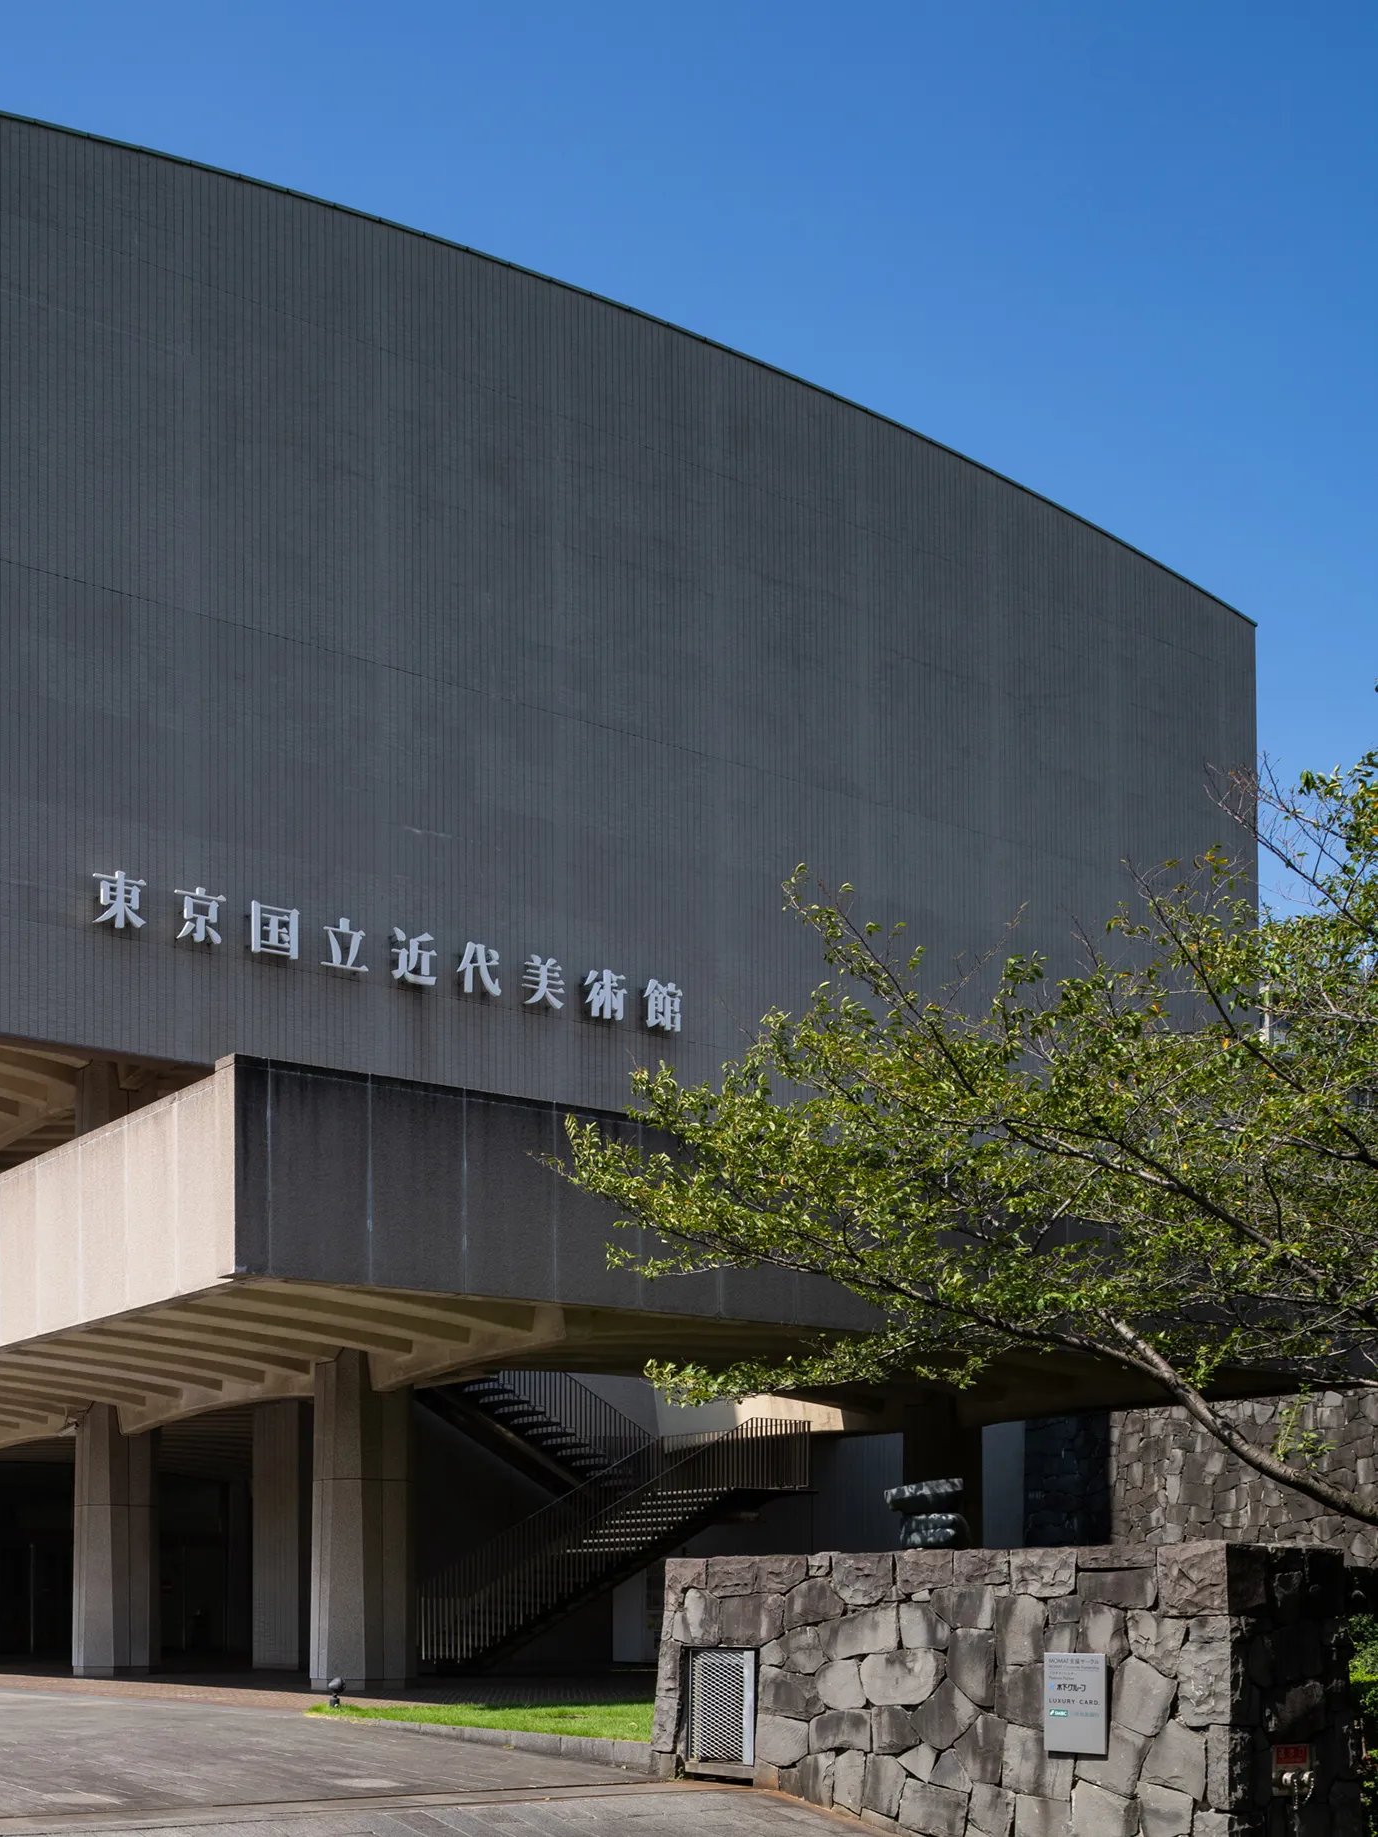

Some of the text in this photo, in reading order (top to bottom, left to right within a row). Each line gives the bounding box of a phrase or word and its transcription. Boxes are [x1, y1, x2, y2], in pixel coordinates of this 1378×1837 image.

[92, 870, 684, 1033] 東京国立近代美術館
